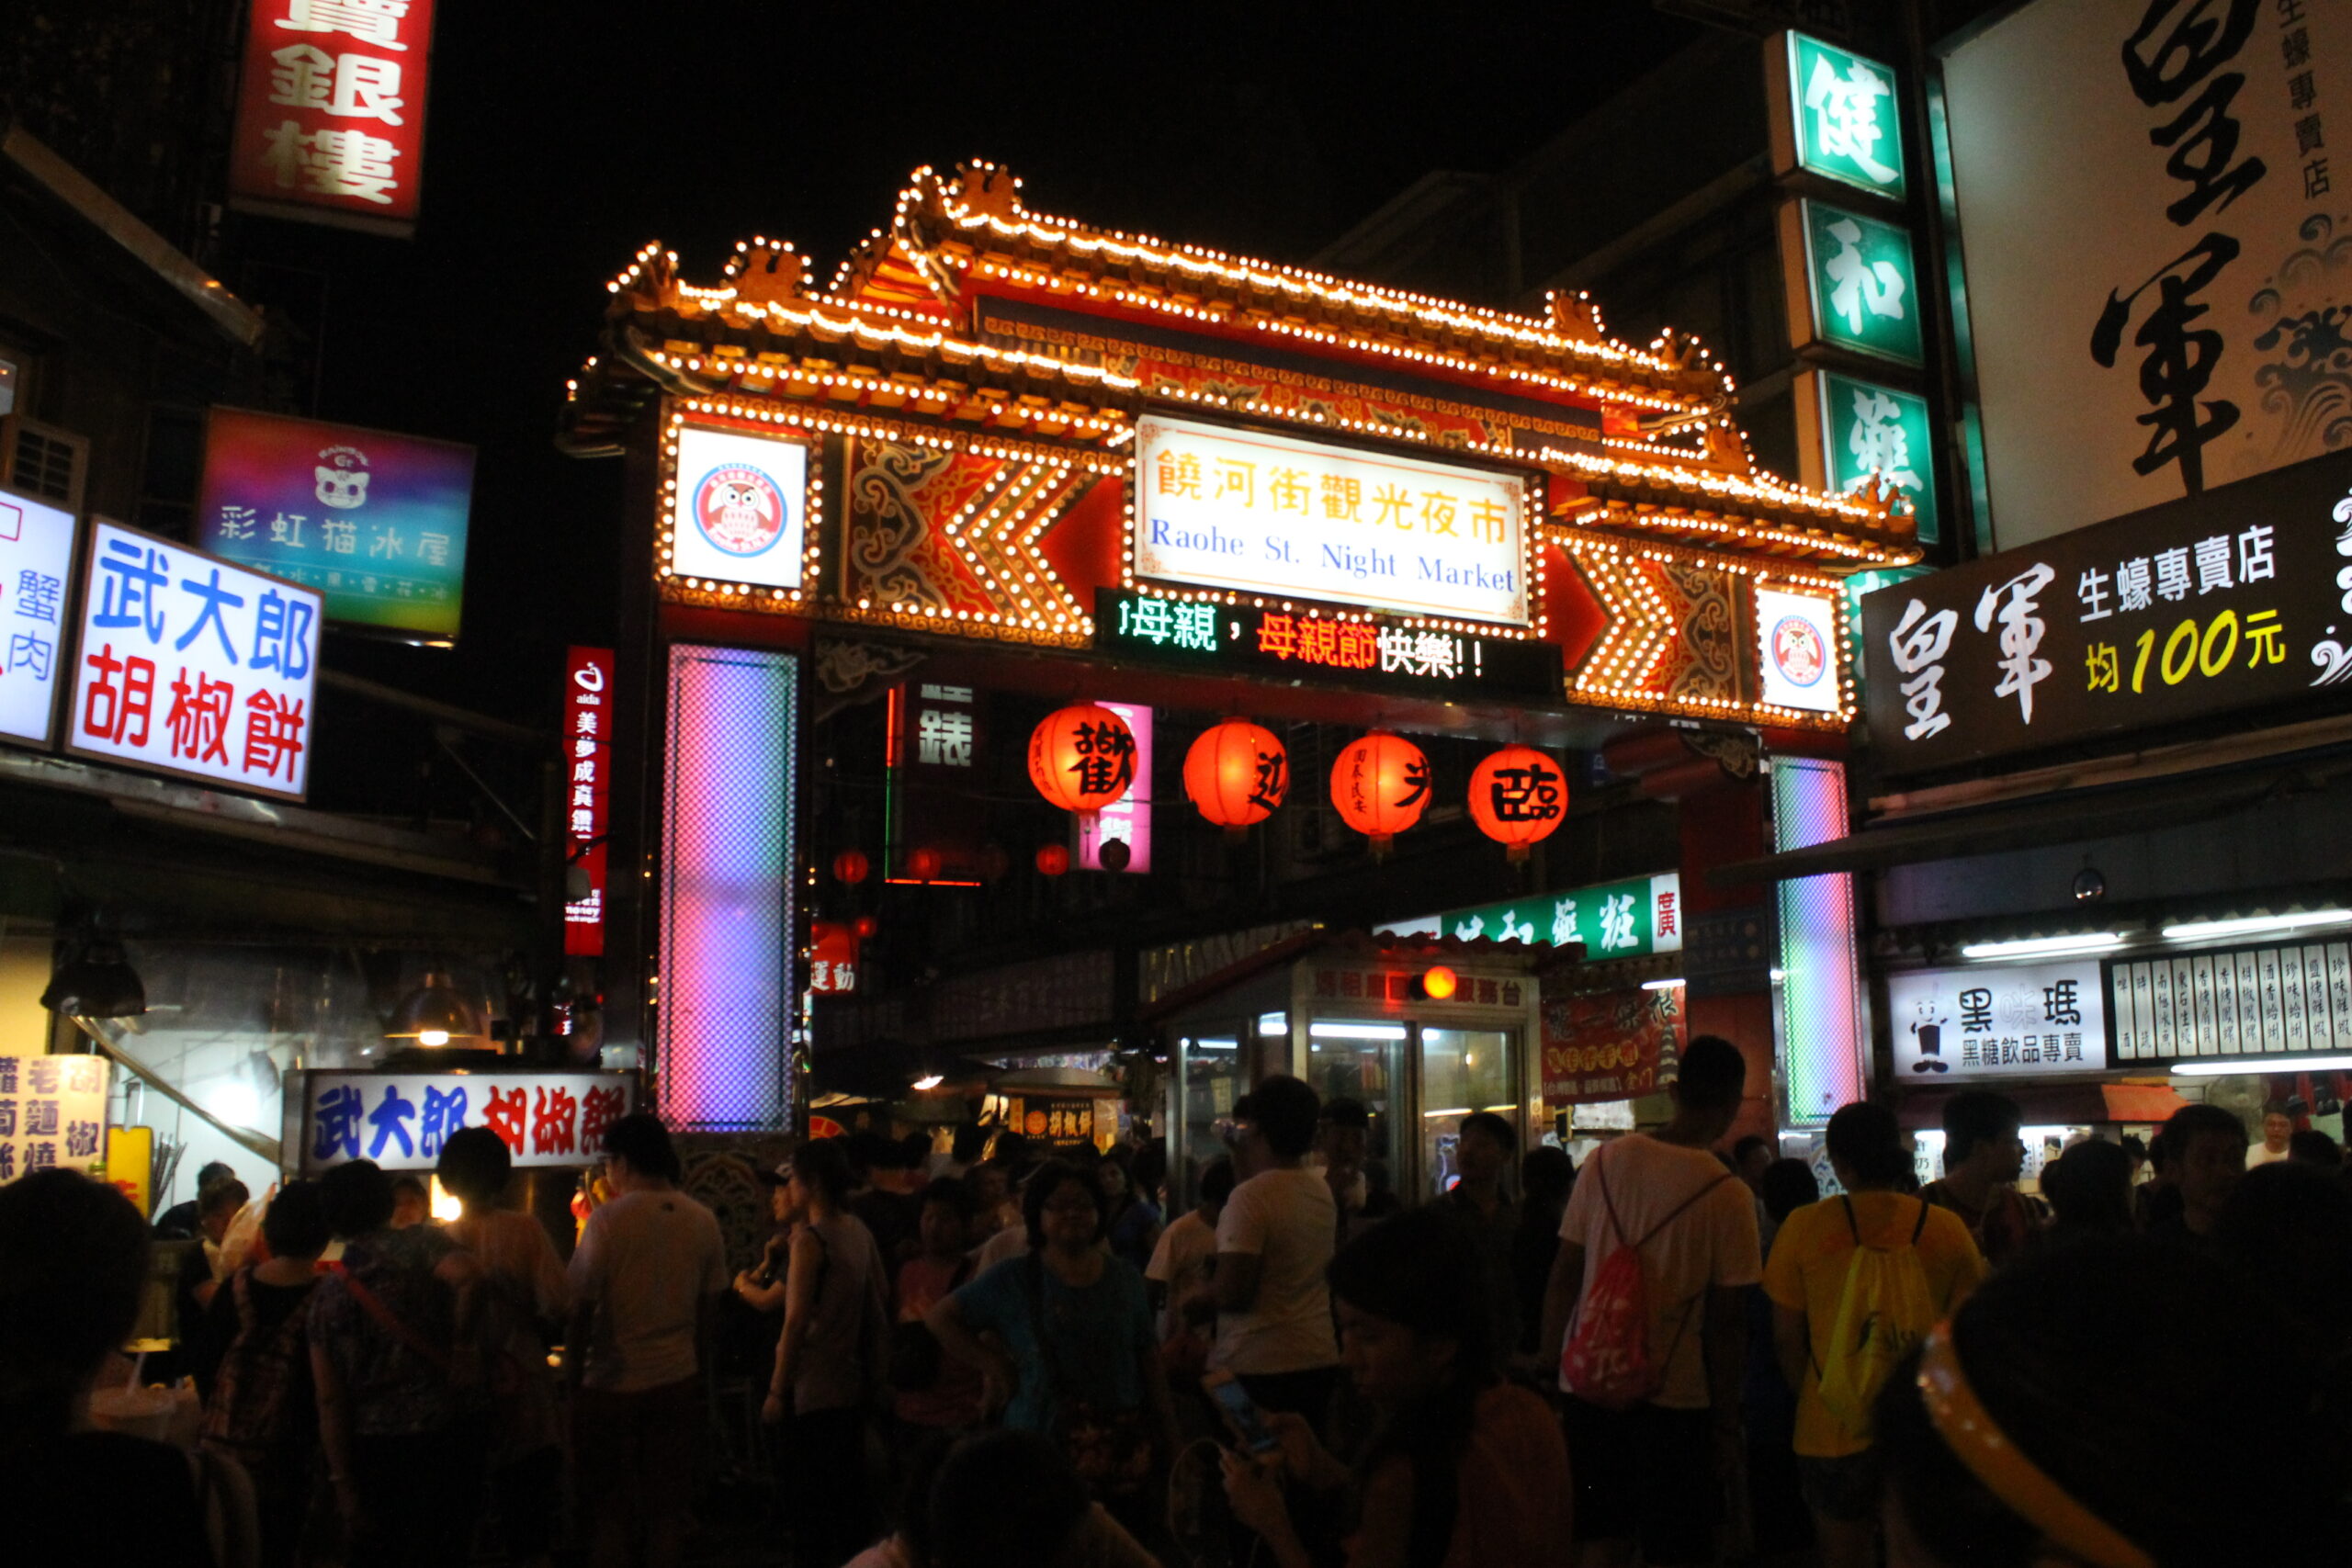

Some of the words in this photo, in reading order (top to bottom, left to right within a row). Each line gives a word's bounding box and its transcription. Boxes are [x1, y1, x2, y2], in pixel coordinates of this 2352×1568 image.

[1155, 448, 1509, 546] 饒河街觀光夜市
[1149, 517, 1245, 557] Raohe
[1264, 535, 1301, 564] St.
[1321, 543, 1397, 579] Night
[1418, 556, 1516, 593] Market
[2077, 525, 2278, 625] 生蠔專賣店
[7, 569, 61, 682] 蟹肉
[93, 538, 314, 682] 武大郎
[1888, 561, 2057, 743] 皇軍
[2084, 608, 2288, 695] 均100元
[84, 643, 306, 784] 胡椒餅
[919, 683, 974, 768] 錶
[1491, 763, 1561, 822] 臨
[810, 961, 855, 991] 運動
[1962, 1032, 2084, 1067] 黑糖飲品專賣
